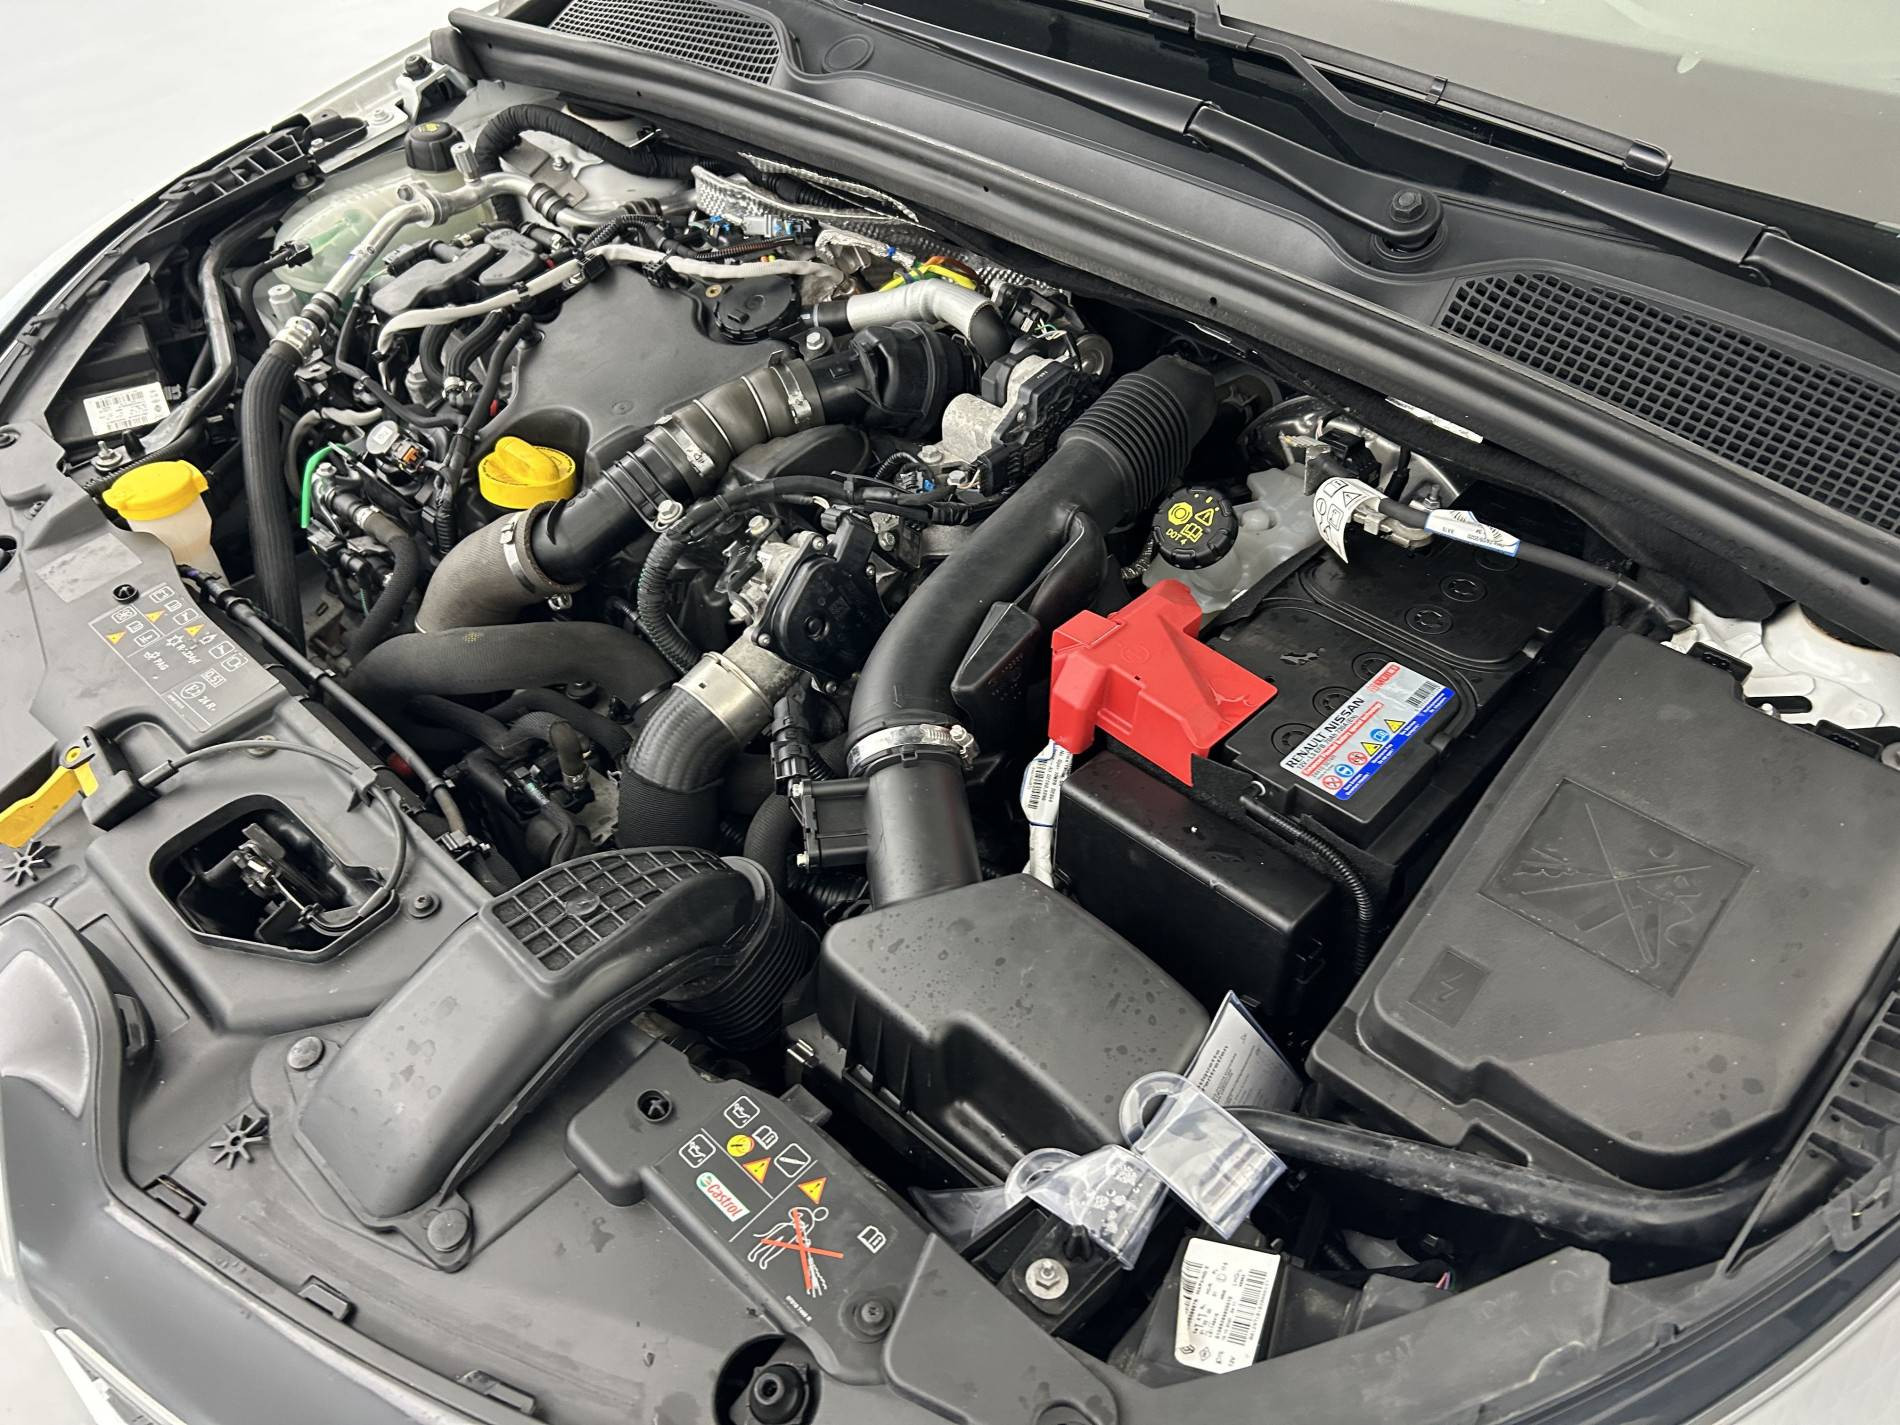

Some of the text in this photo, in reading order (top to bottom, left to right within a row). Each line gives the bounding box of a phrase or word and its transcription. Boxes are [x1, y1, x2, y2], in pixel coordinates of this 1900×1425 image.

[1166, 528, 1182, 541] DOT
[154, 654, 169, 671] PAG
[1285, 732, 1326, 768] RENAULT
[1323, 696, 1365, 732] NISSAN
[707, 1184, 743, 1216] Castrol
